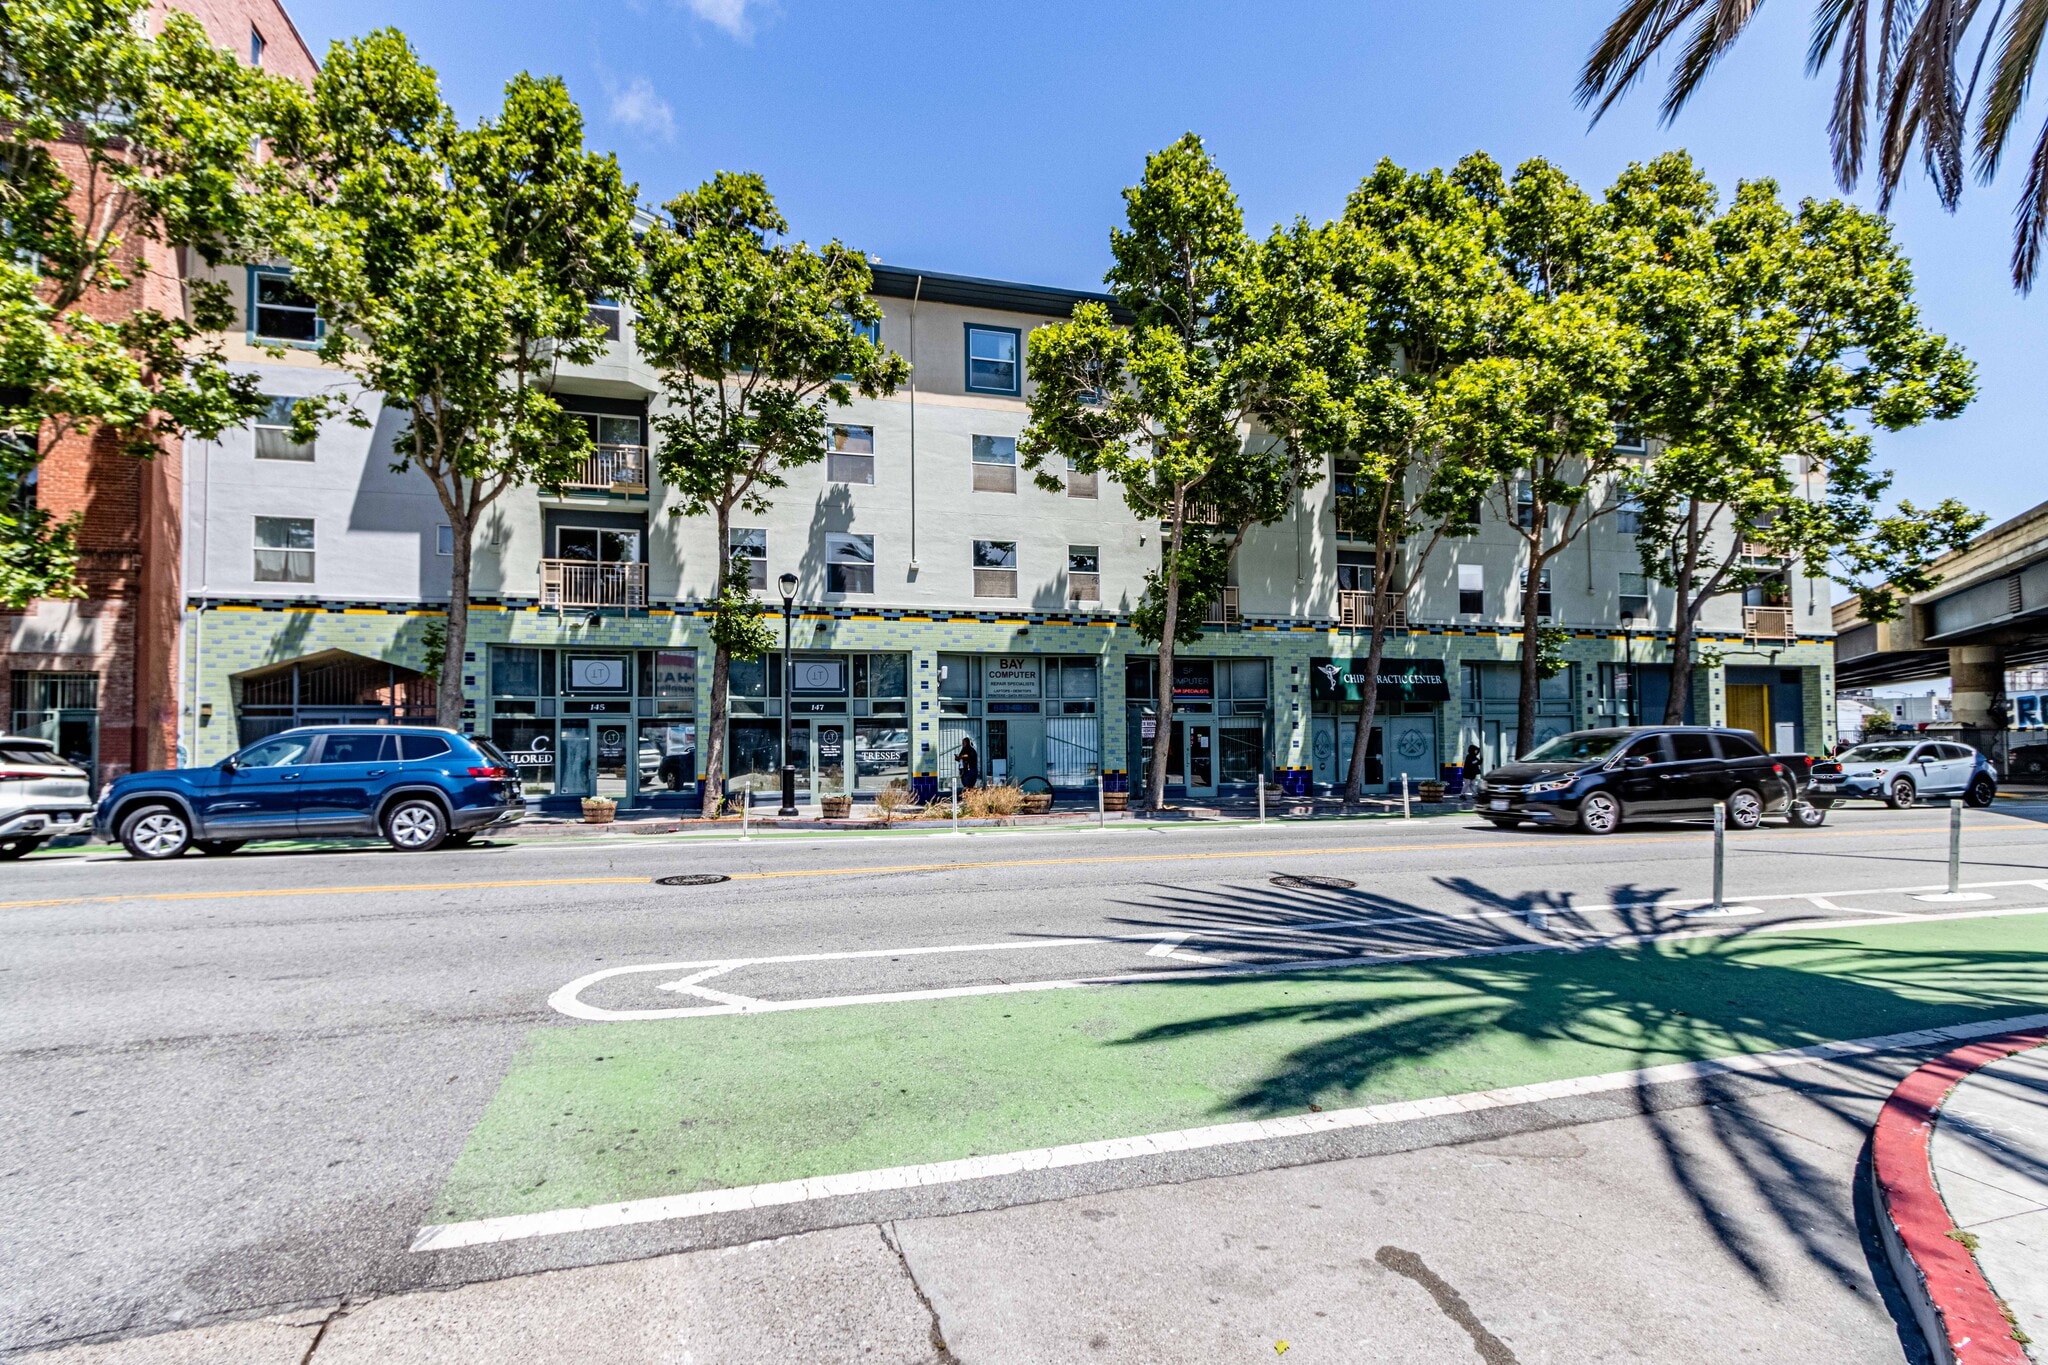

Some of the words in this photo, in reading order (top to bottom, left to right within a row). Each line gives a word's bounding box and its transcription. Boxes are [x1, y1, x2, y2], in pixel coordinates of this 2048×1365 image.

[999, 658, 1025, 669] BAY
[988, 670, 1036, 679] COMPUTER
[1343, 673, 1408, 684] CHIRRACTIC
[1408, 673, 1442, 684] CENTER
[1173, 677, 1209, 685] OMPUTER
[590, 703, 606, 711] 145
[861, 751, 901, 760] TRESSES
